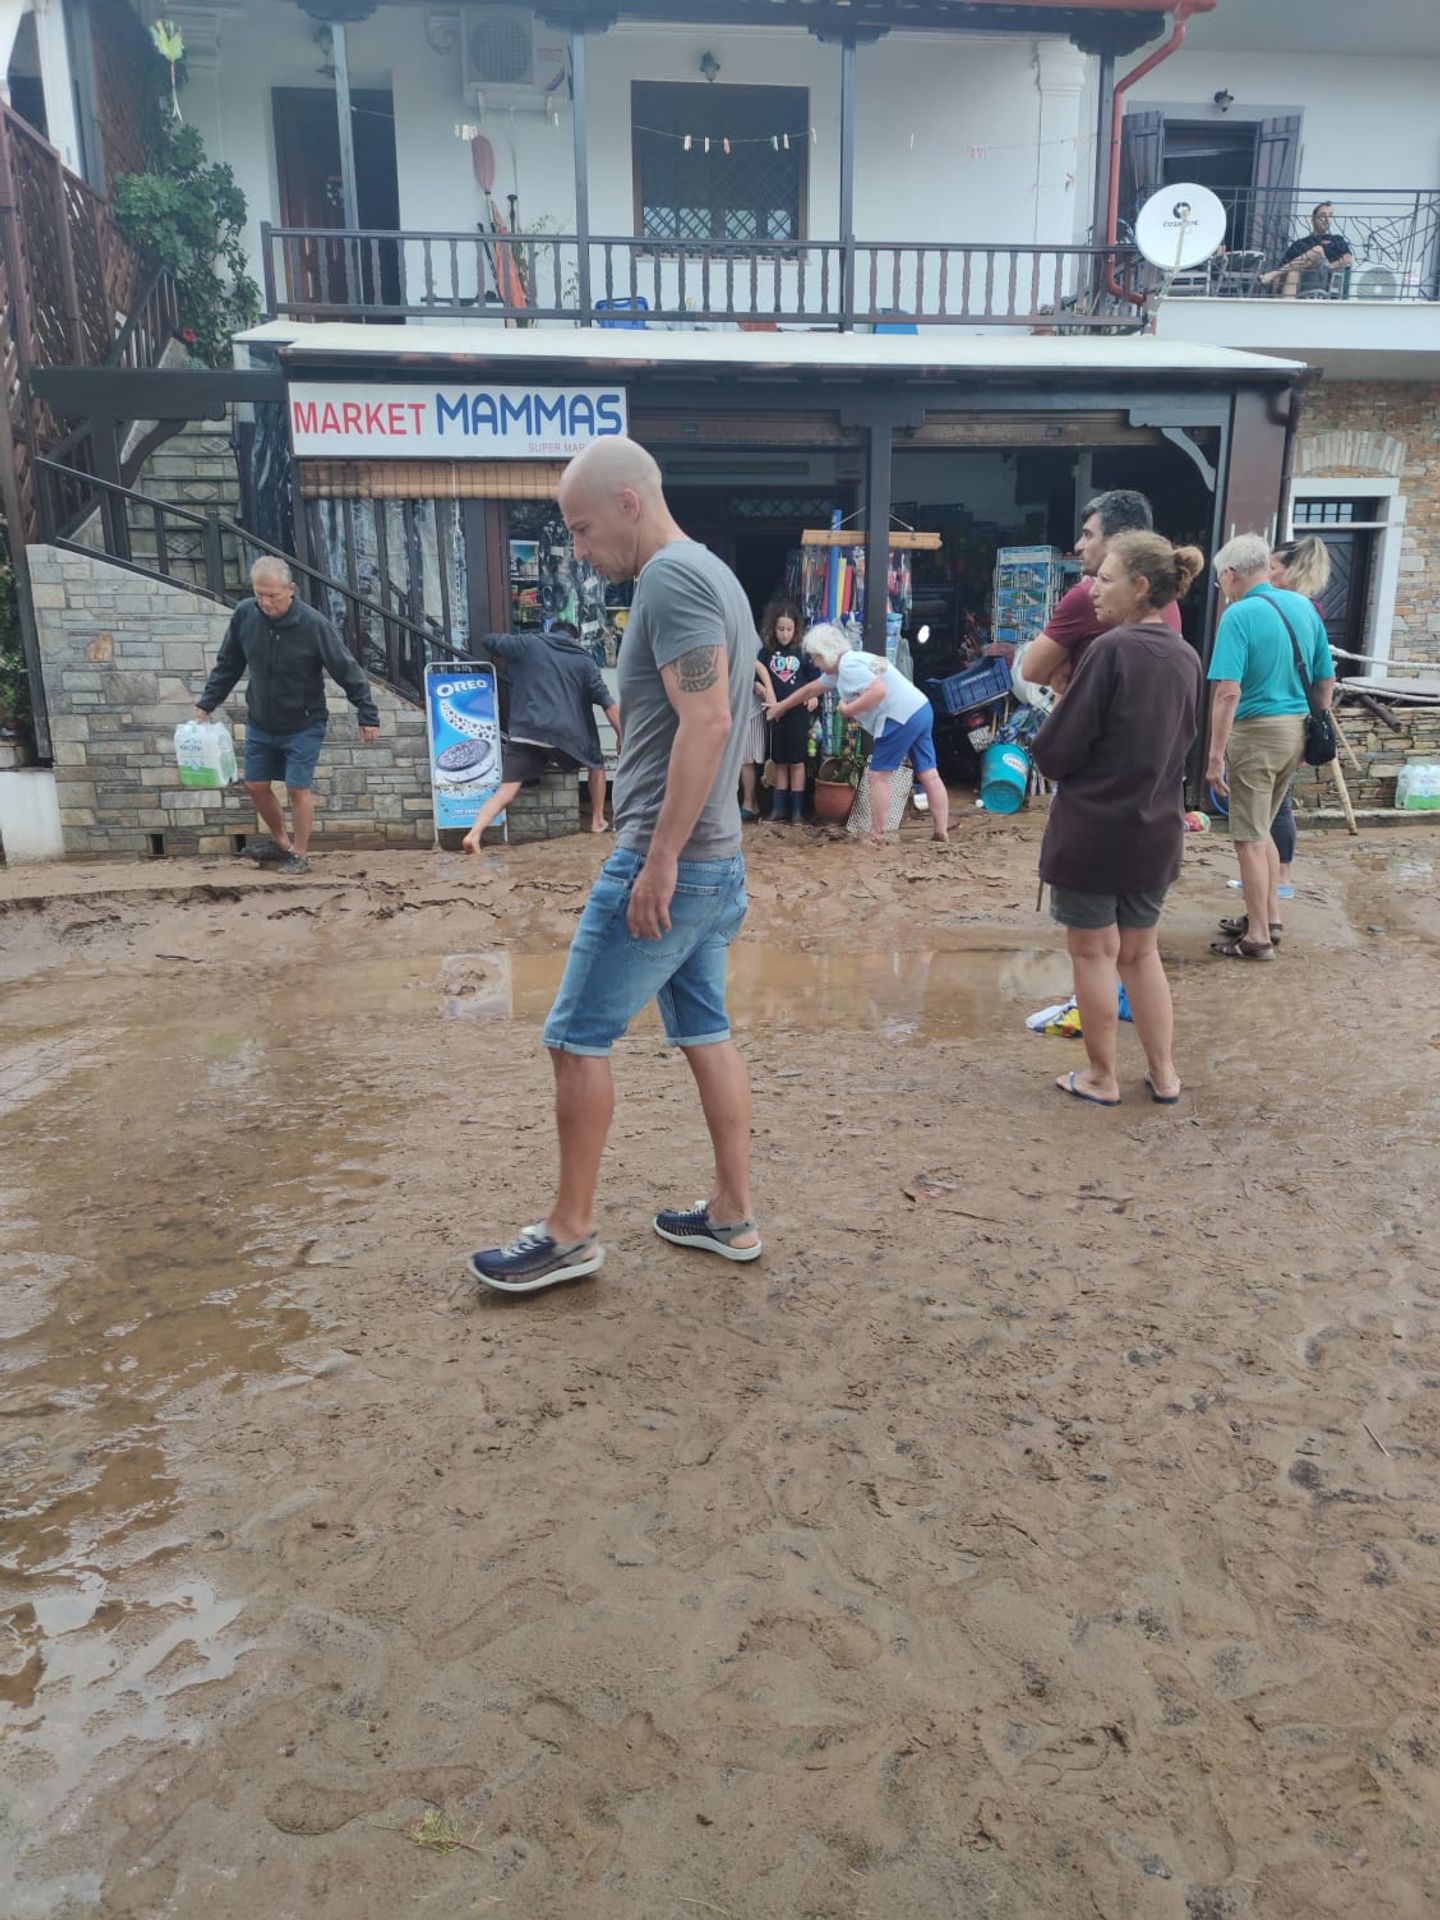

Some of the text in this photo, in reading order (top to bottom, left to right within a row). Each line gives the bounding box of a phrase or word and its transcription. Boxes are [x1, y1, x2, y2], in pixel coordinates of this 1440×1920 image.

[292, 392, 623, 437] MARKET MAMMAS
[528, 442, 586, 453] SUPER MAR
[436, 679, 488, 698] OREO
